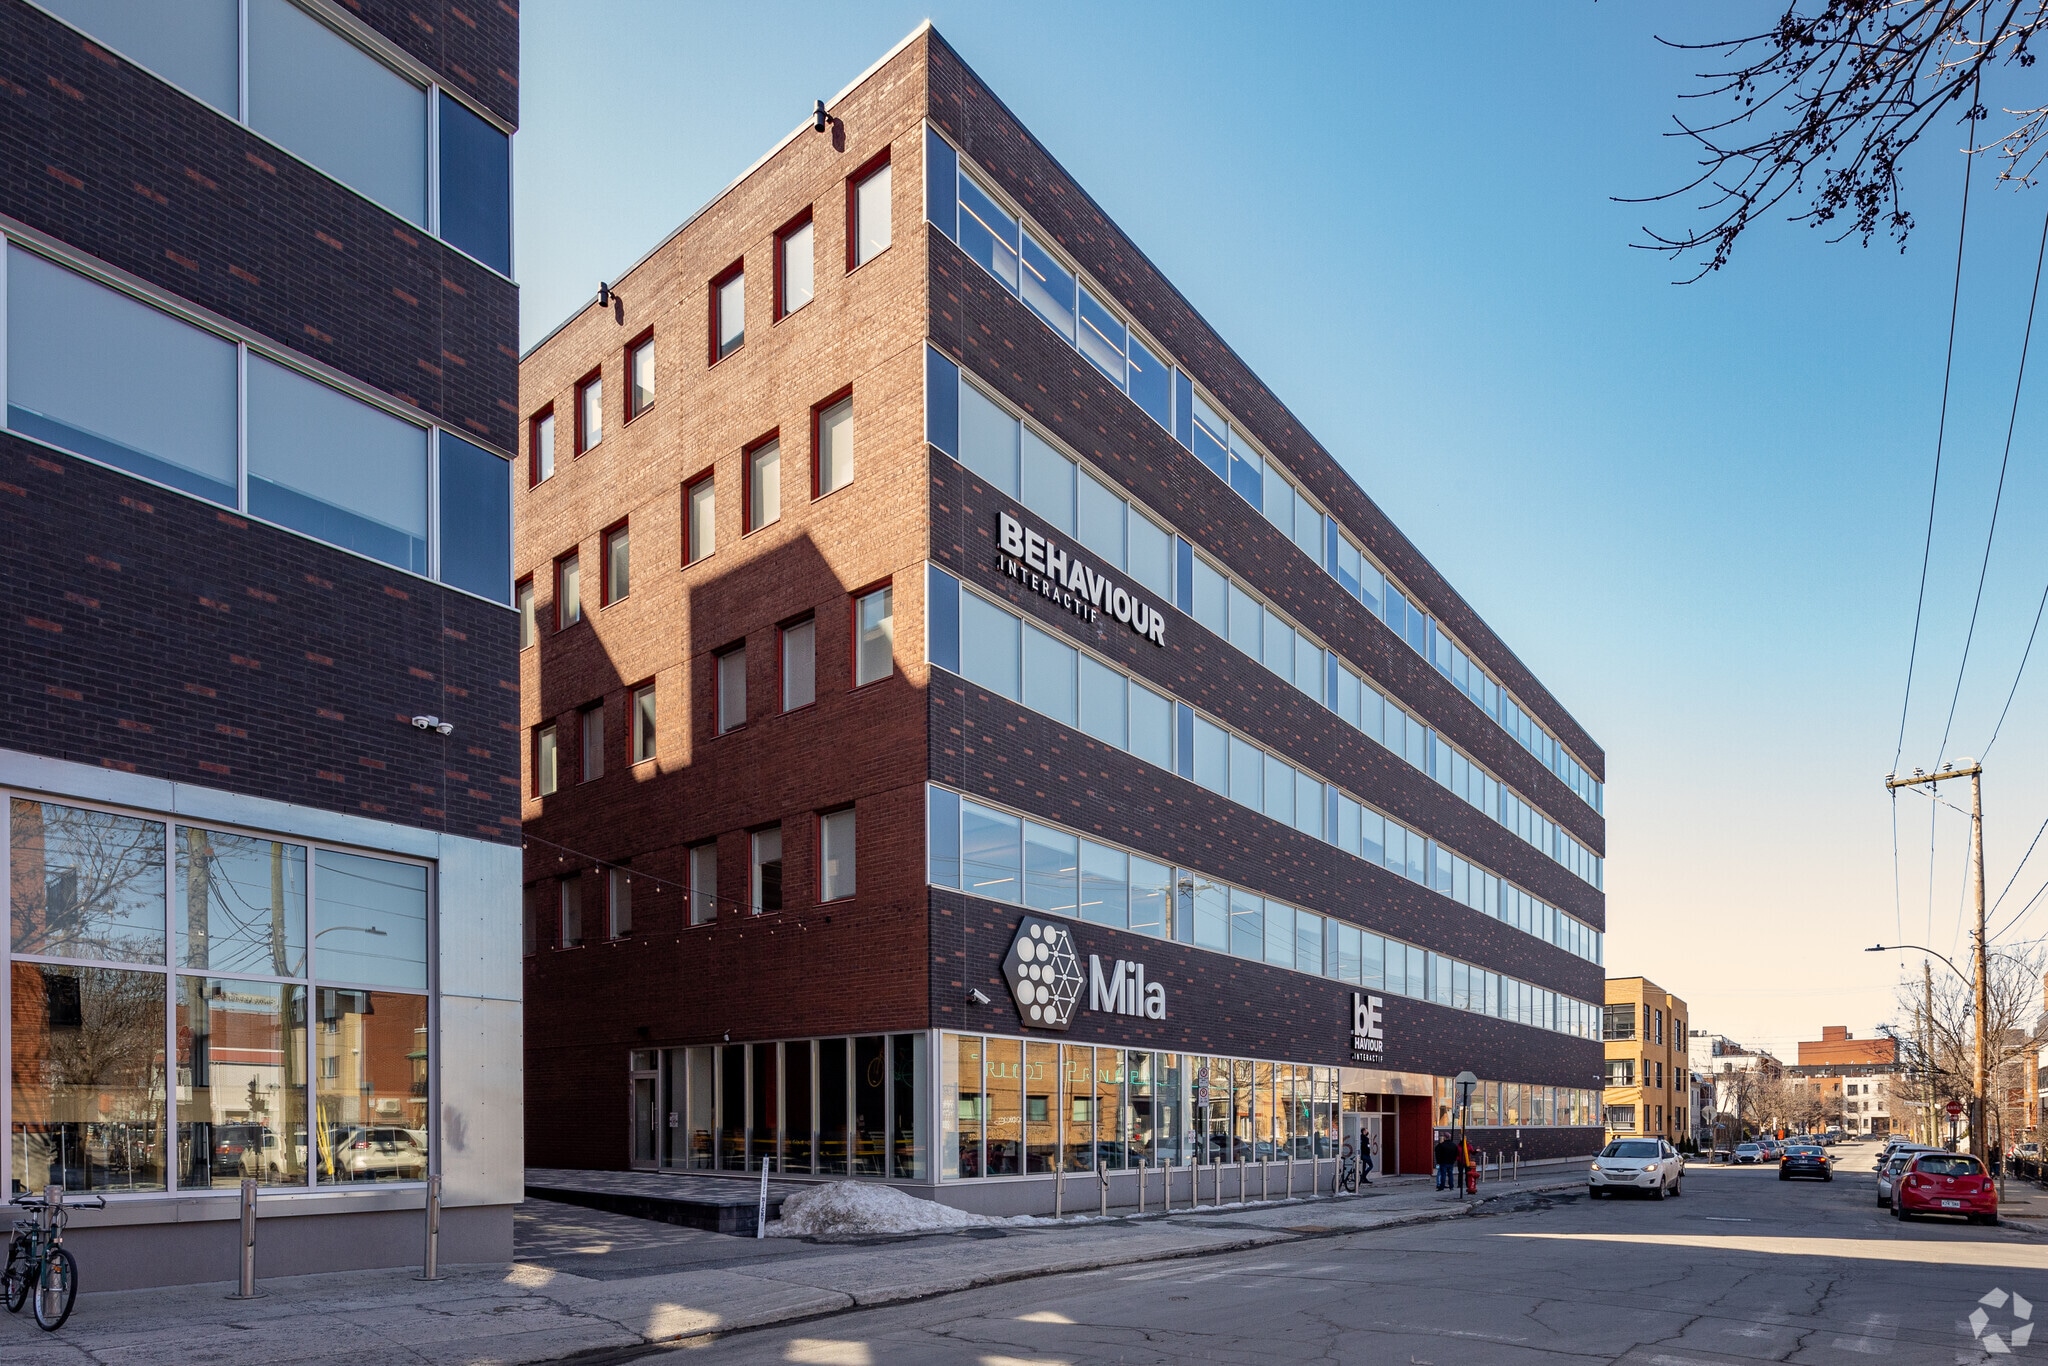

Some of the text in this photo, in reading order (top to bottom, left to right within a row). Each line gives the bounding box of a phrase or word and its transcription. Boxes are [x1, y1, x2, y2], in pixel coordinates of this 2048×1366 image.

[1000, 511, 1166, 647] BEHAVIOUR
[1000, 554, 1097, 623] INTERACTIF
[1089, 954, 1166, 1020] Mila
[1354, 992, 1383, 1039] bE
[1353, 1052, 1383, 1063] INTERACTIF
[1354, 1036, 1383, 1053] HAVIOUR
